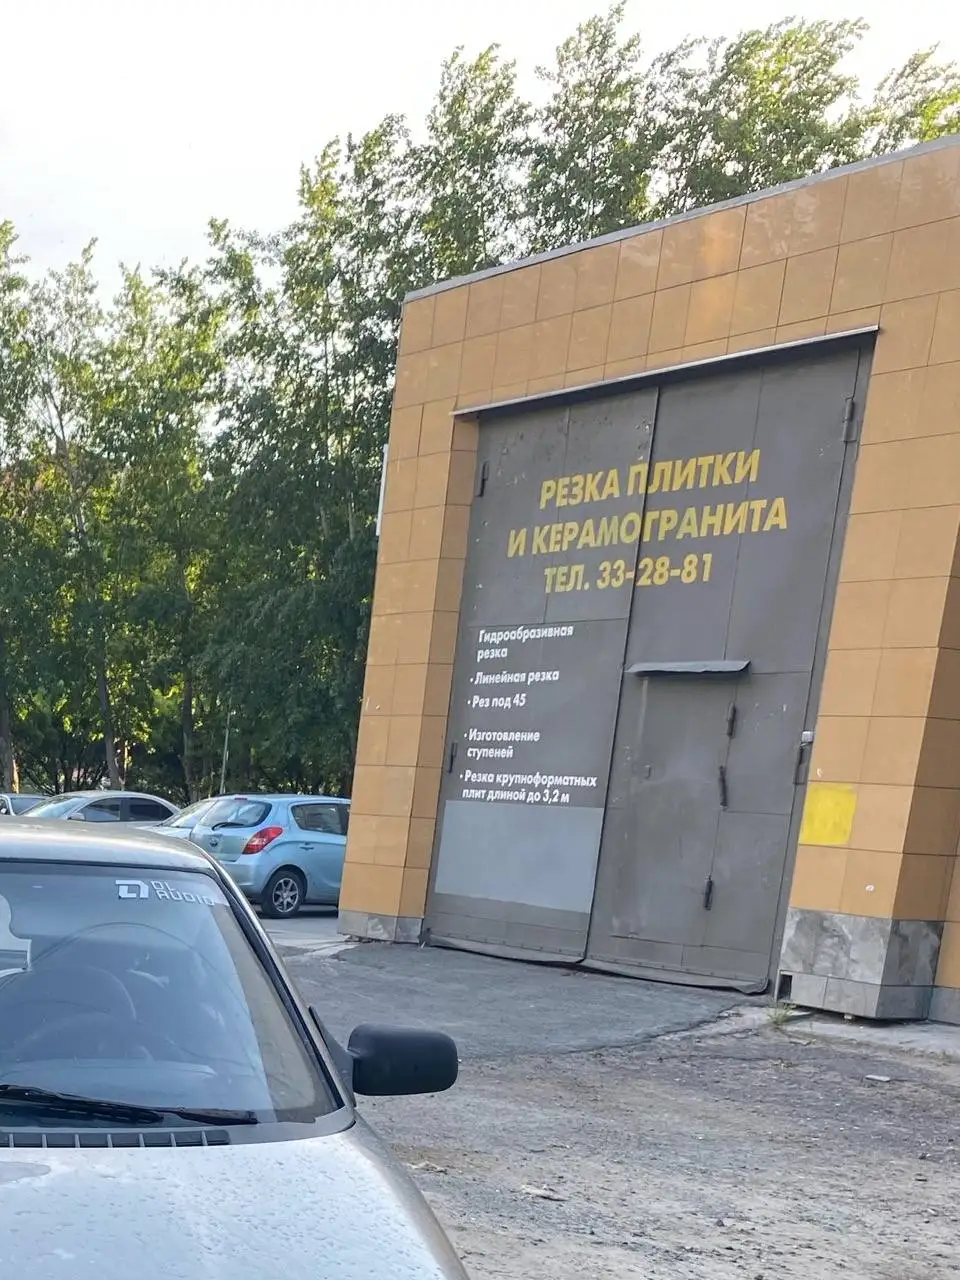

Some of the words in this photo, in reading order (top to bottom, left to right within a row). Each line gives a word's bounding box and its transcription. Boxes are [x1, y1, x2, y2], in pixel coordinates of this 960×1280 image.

[540, 468, 620, 511] РЕЗКА
[627, 449, 761, 496] ПЛИТКИ
[507, 528, 527, 558] И
[531, 497, 788, 555] КЕРАМОГРАНИТА
[544, 564, 590, 594] ТЕЛ.
[596, 553, 713, 590] 33-28-81
[478, 625, 574, 645] Гидроабразивная
[476, 647, 508, 662] резка
[474, 671, 526, 685] Линейная
[527, 670, 560, 685] резка
[472, 695, 490, 708] Рез
[491, 696, 512, 709] под
[512, 693, 526, 706] 45
[468, 728, 541, 742] Изготовление
[467, 746, 514, 760] ступеней
[464, 770, 494, 783] Резка
[495, 772, 597, 788] крупноформатных
[462, 788, 487, 799] плит
[488, 788, 526, 801] длиной
[526, 793, 541, 803] до
[542, 789, 559, 804] 3,2
[560, 793, 570, 803] м
[155, 890, 215, 906] AUDIO
